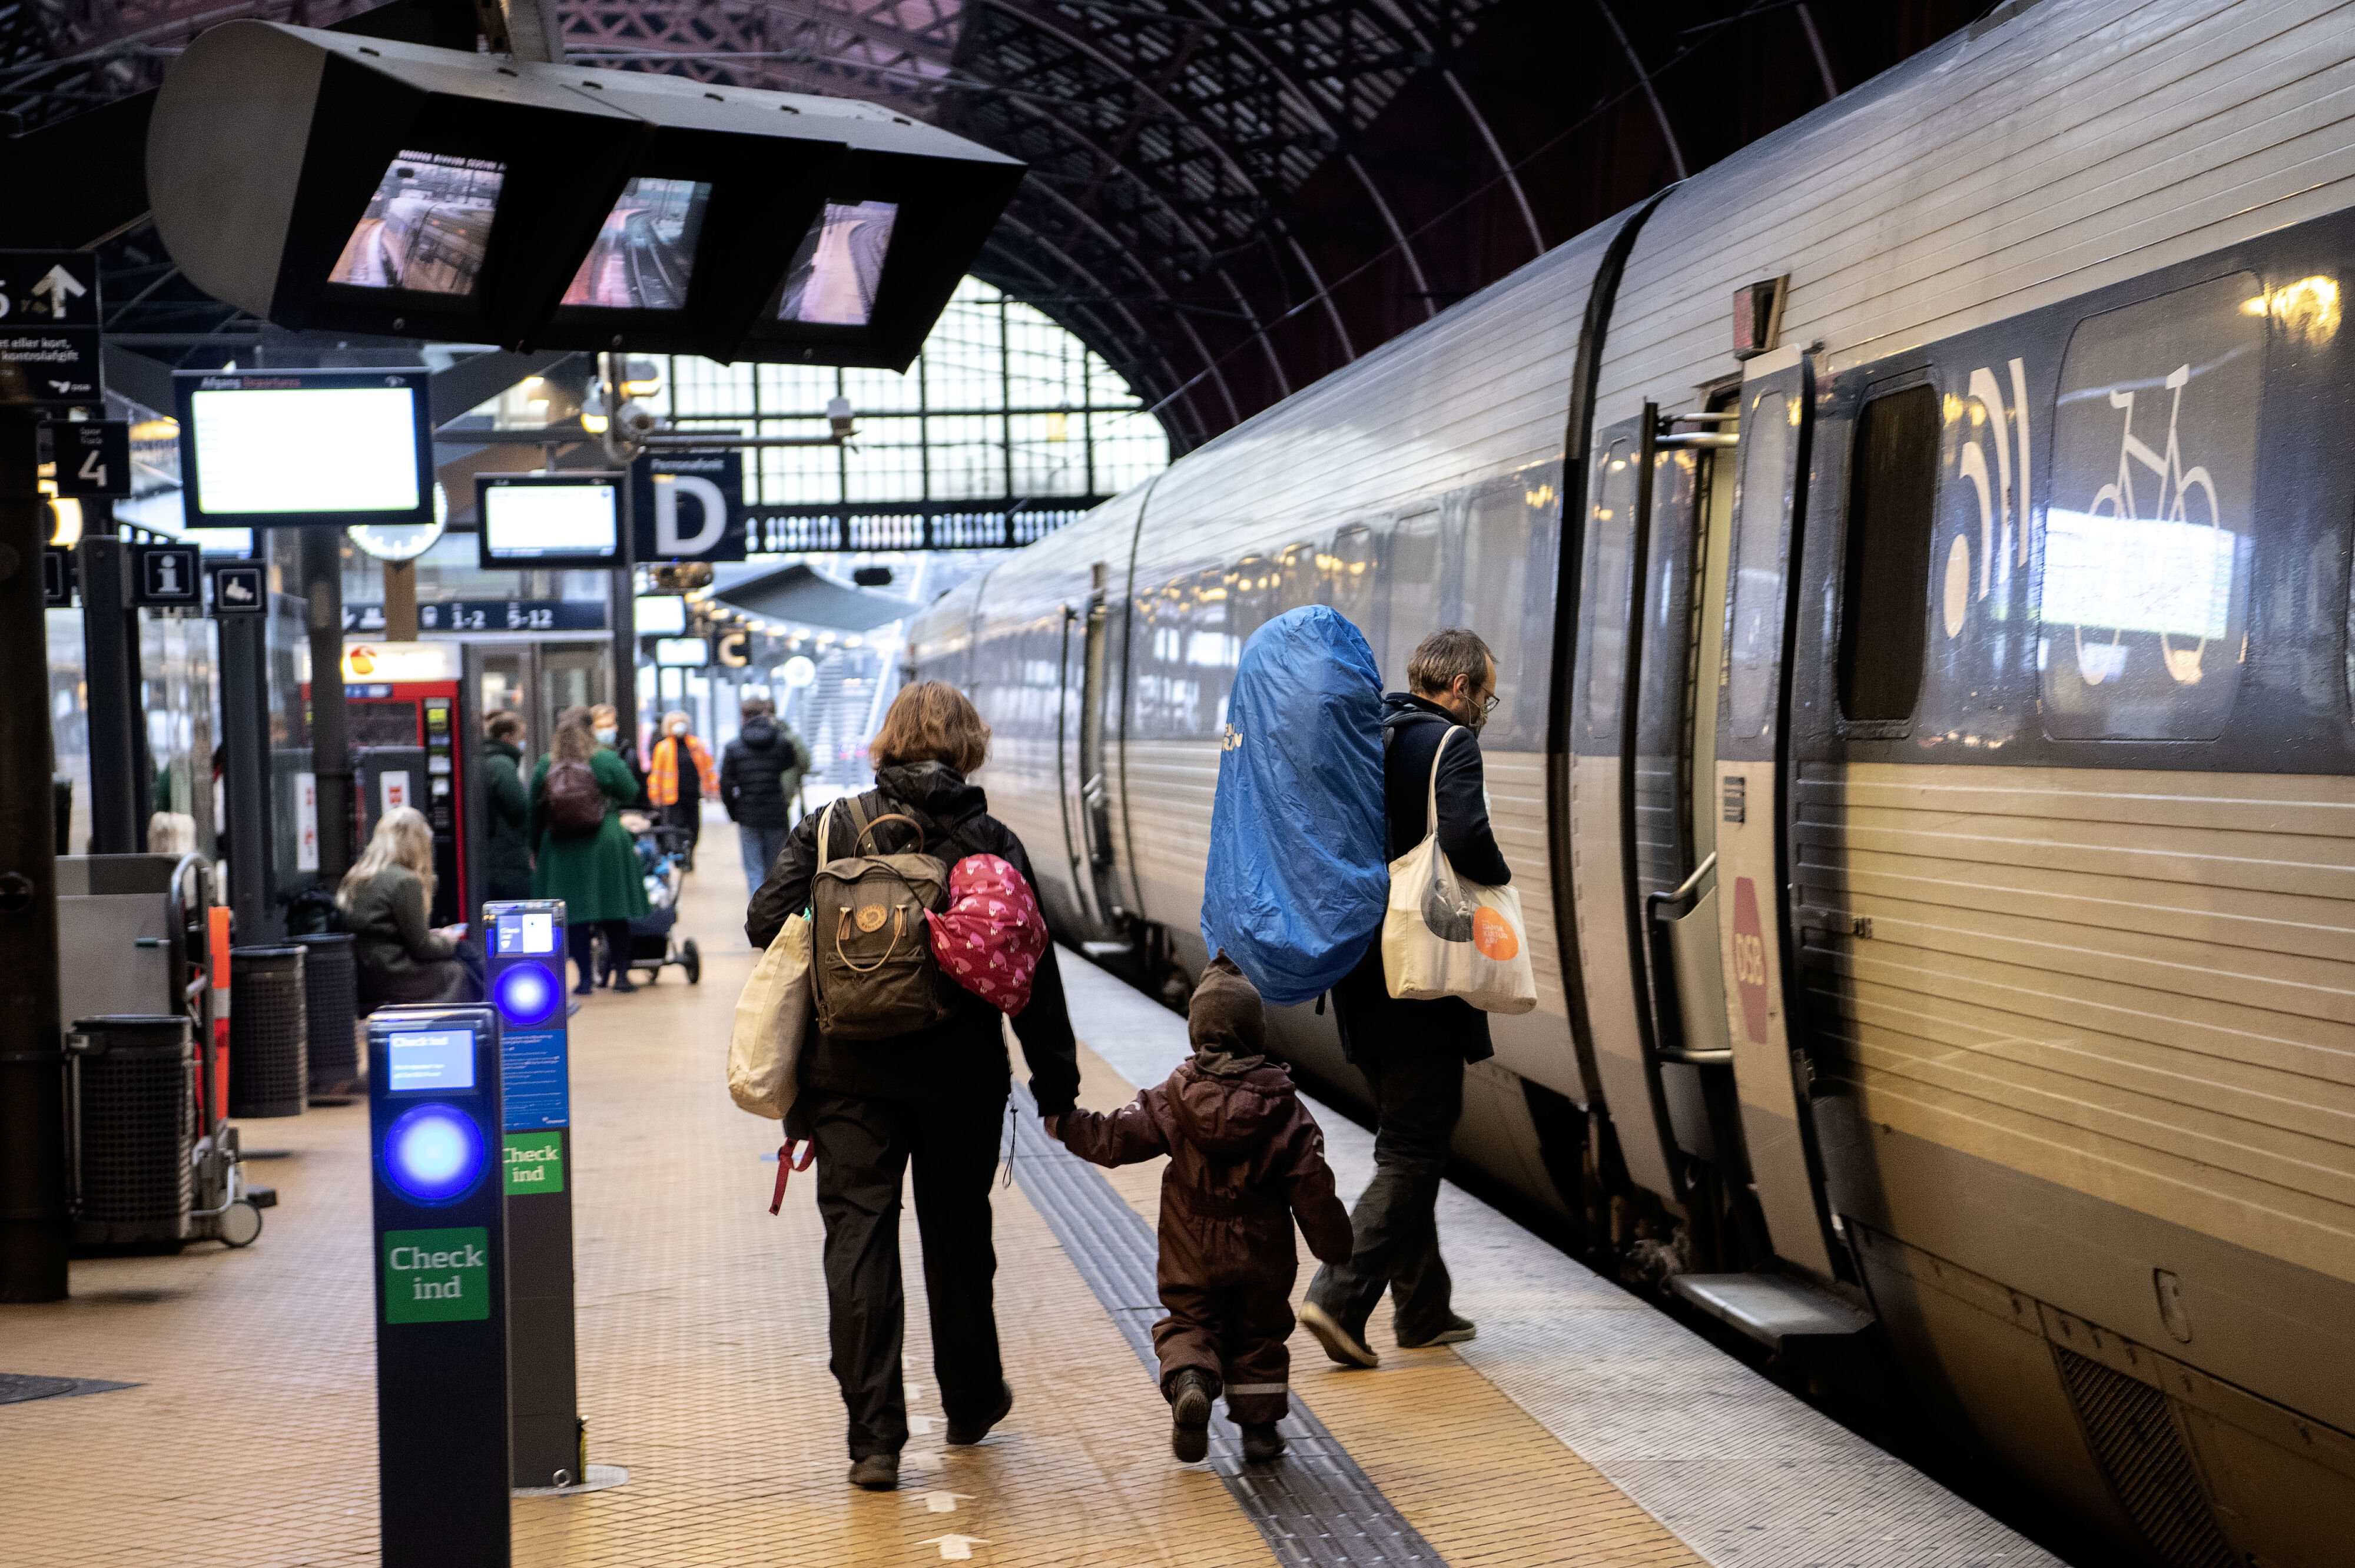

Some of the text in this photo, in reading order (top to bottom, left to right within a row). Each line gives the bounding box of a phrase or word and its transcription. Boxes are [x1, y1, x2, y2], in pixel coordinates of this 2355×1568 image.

[78, 450, 107, 487] 4
[655, 476, 727, 556] D
[718, 633, 747, 667] C
[512, 1165, 545, 1182] ind
[390, 1244, 485, 1270] Check
[413, 1275, 462, 1300] ind
